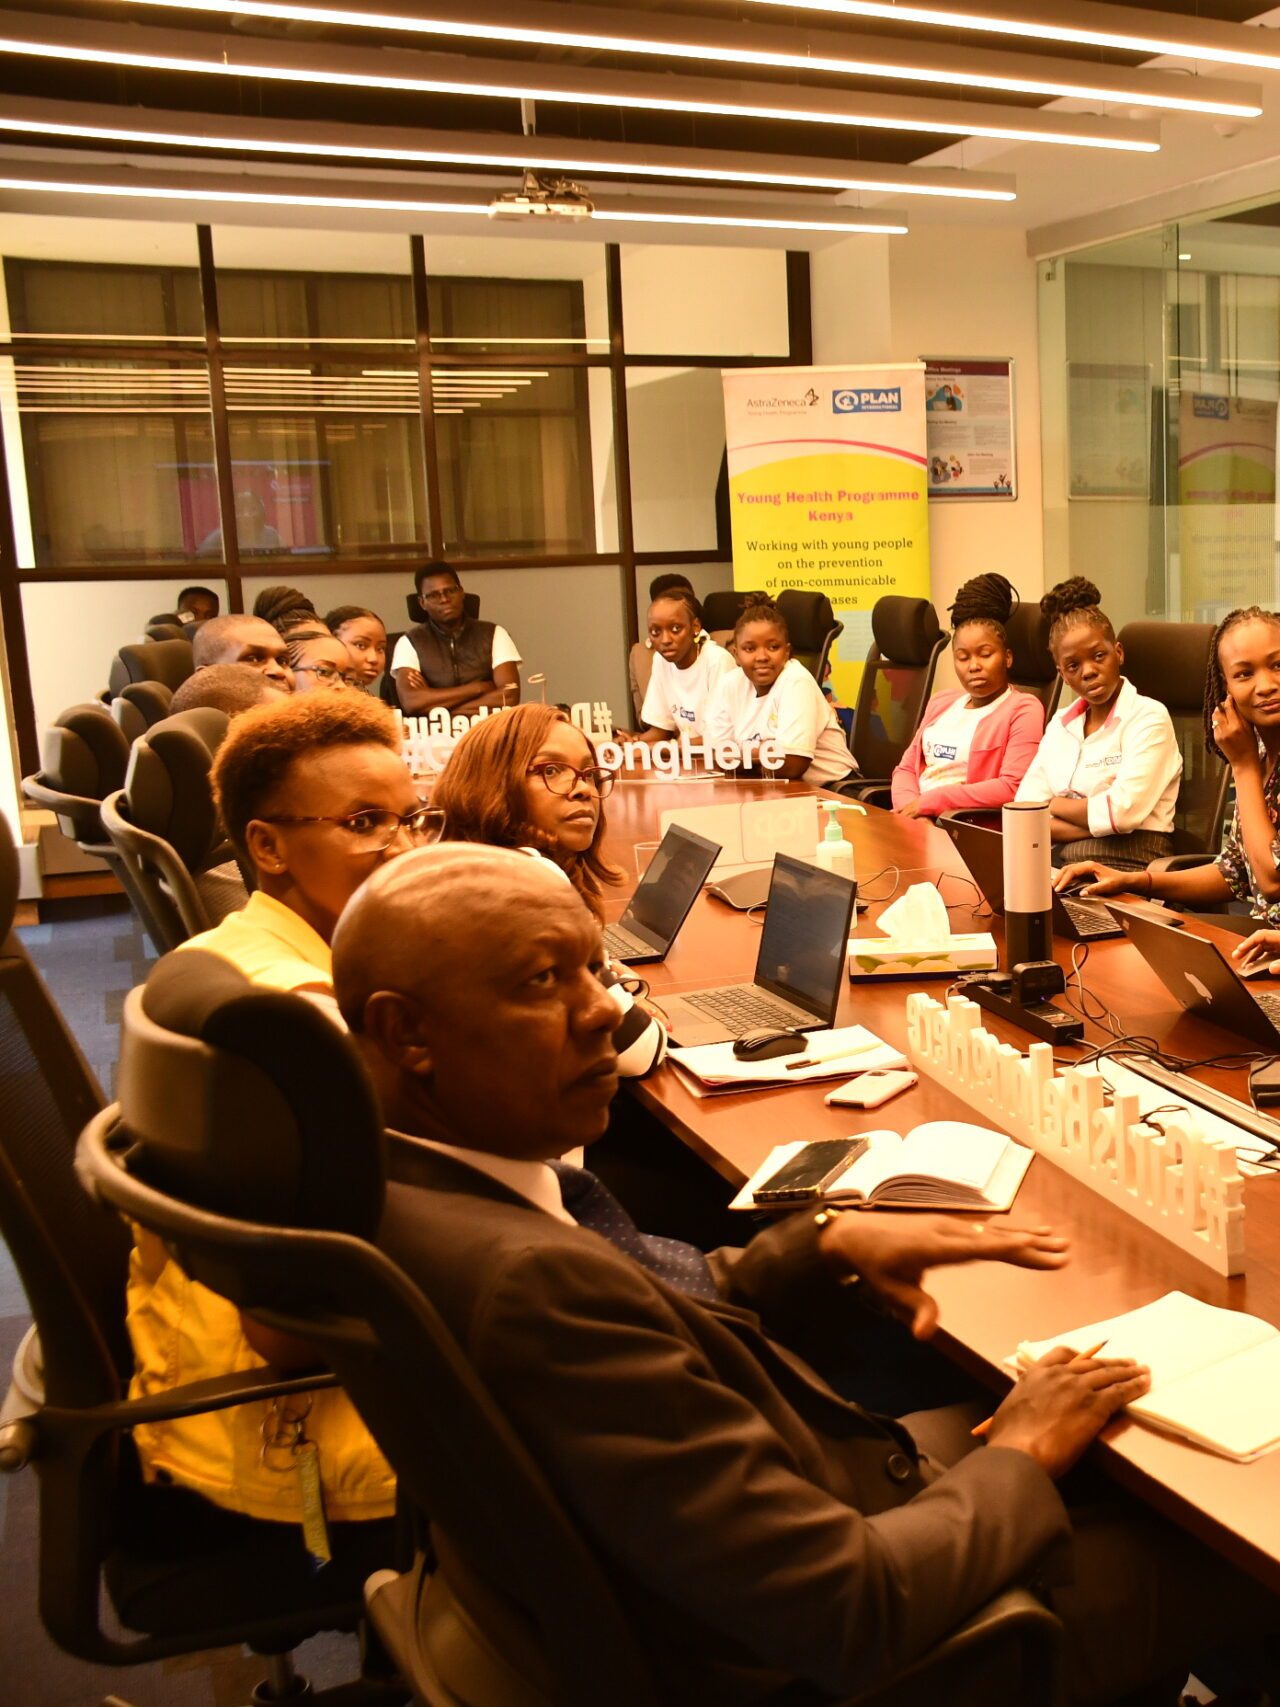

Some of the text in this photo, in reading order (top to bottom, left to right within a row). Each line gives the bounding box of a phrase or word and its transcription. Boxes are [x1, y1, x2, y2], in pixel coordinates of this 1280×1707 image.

[747, 397, 807, 408] AstraZeneca
[860, 391, 899, 404] PLAN
[737, 490, 919, 505] Young Health Programme
[808, 510, 853, 523] Kenya
[746, 537, 913, 552] Working with young people
[777, 557, 883, 570] on the prevention
[765, 575, 896, 588] of non-communicable
[831, 595, 858, 605] ases
